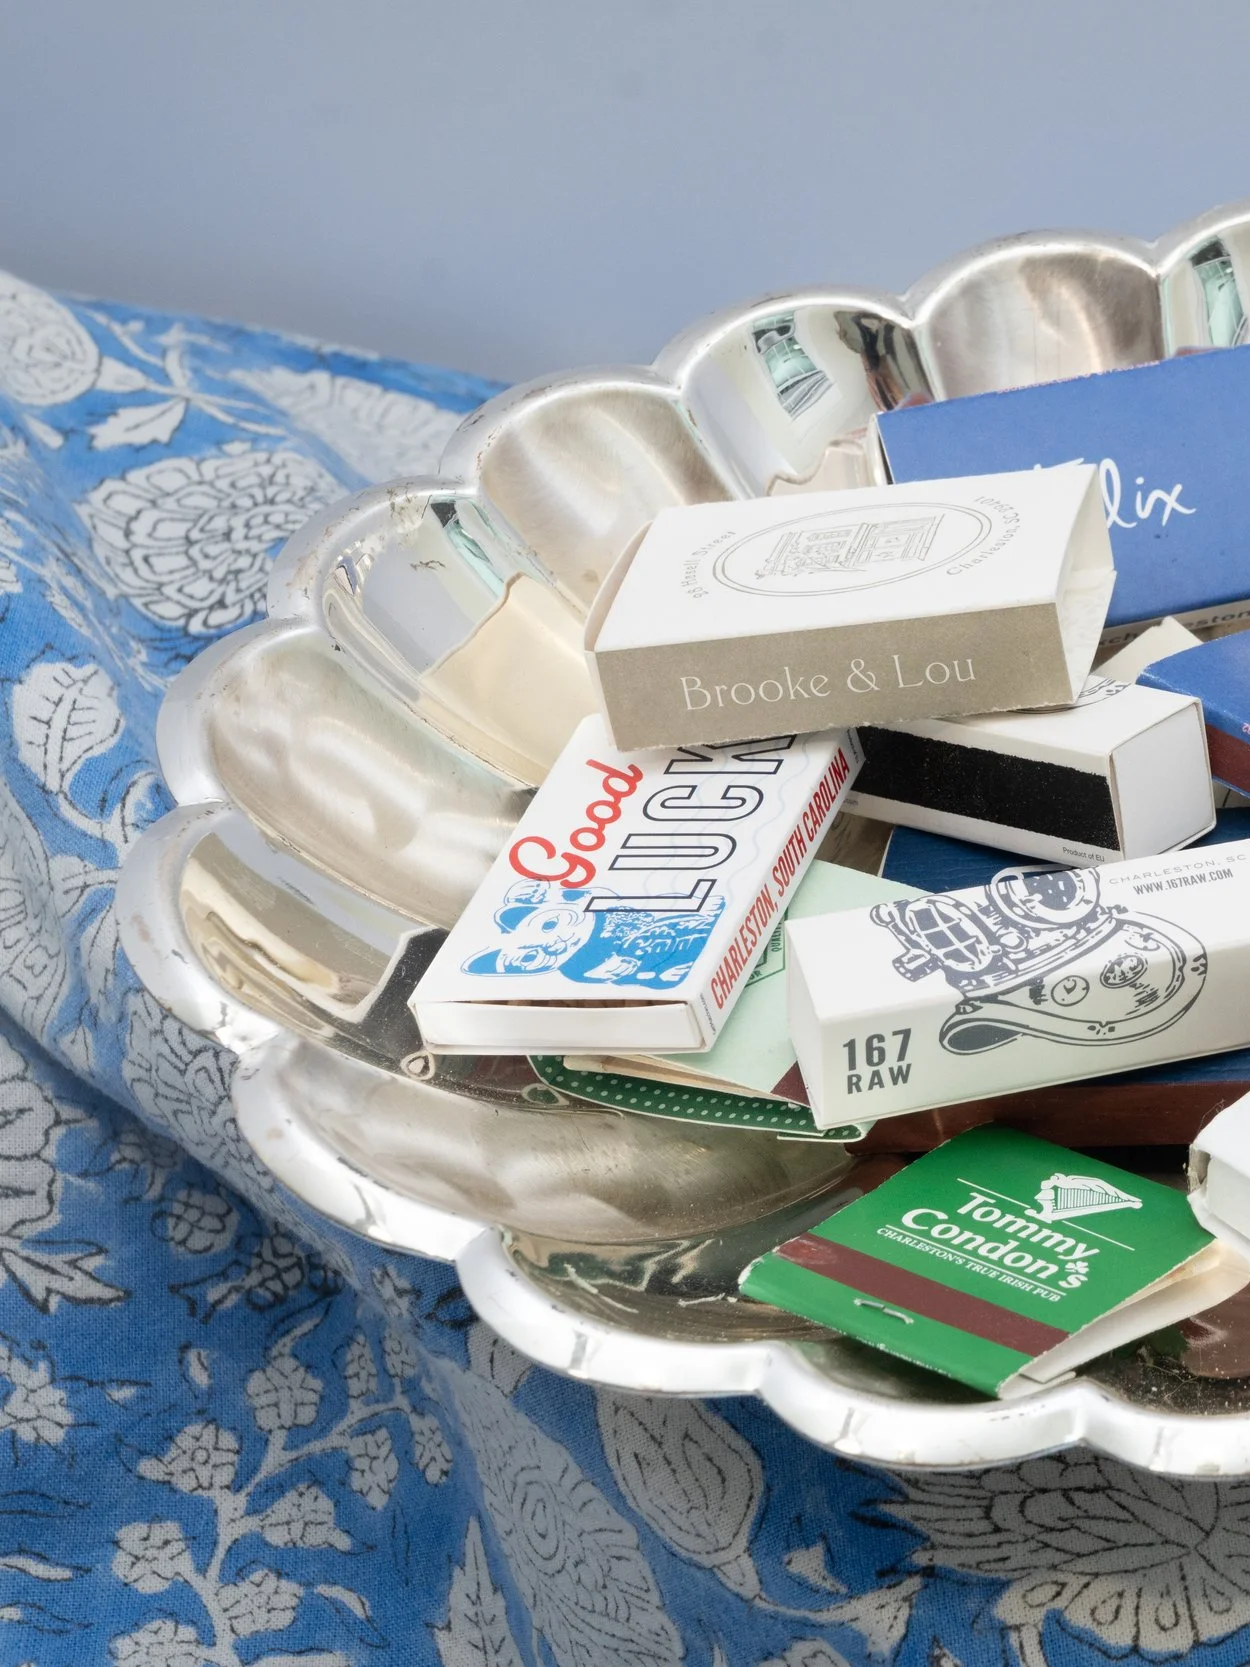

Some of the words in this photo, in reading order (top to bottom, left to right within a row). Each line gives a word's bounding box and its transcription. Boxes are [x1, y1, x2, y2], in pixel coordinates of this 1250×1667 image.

[680, 666, 832, 710] Brooke
[846, 658, 880, 693] &
[892, 654, 976, 689] Lou
[508, 758, 644, 889] Good
[583, 734, 797, 913] LUCK
[710, 883, 778, 1010] CHARLESTON,
[772, 825, 808, 898] SOUTH
[801, 747, 850, 840] CAROLINA
[1062, 846, 1087, 859] Product
[1095, 854, 1105, 863] EU
[1133, 868, 1234, 896] WWW.167RAW.COM
[1225, 853, 1248, 864] SC
[843, 1027, 912, 1072] 167
[847, 1063, 913, 1095] RAW
[957, 1191, 1100, 1260] Tommy
[876, 1227, 965, 1265] CHARLESTON'S
[965, 1260, 998, 1279] TRUE
[998, 1274, 1034, 1293] IRISH
[1032, 1287, 1062, 1302] PUB
